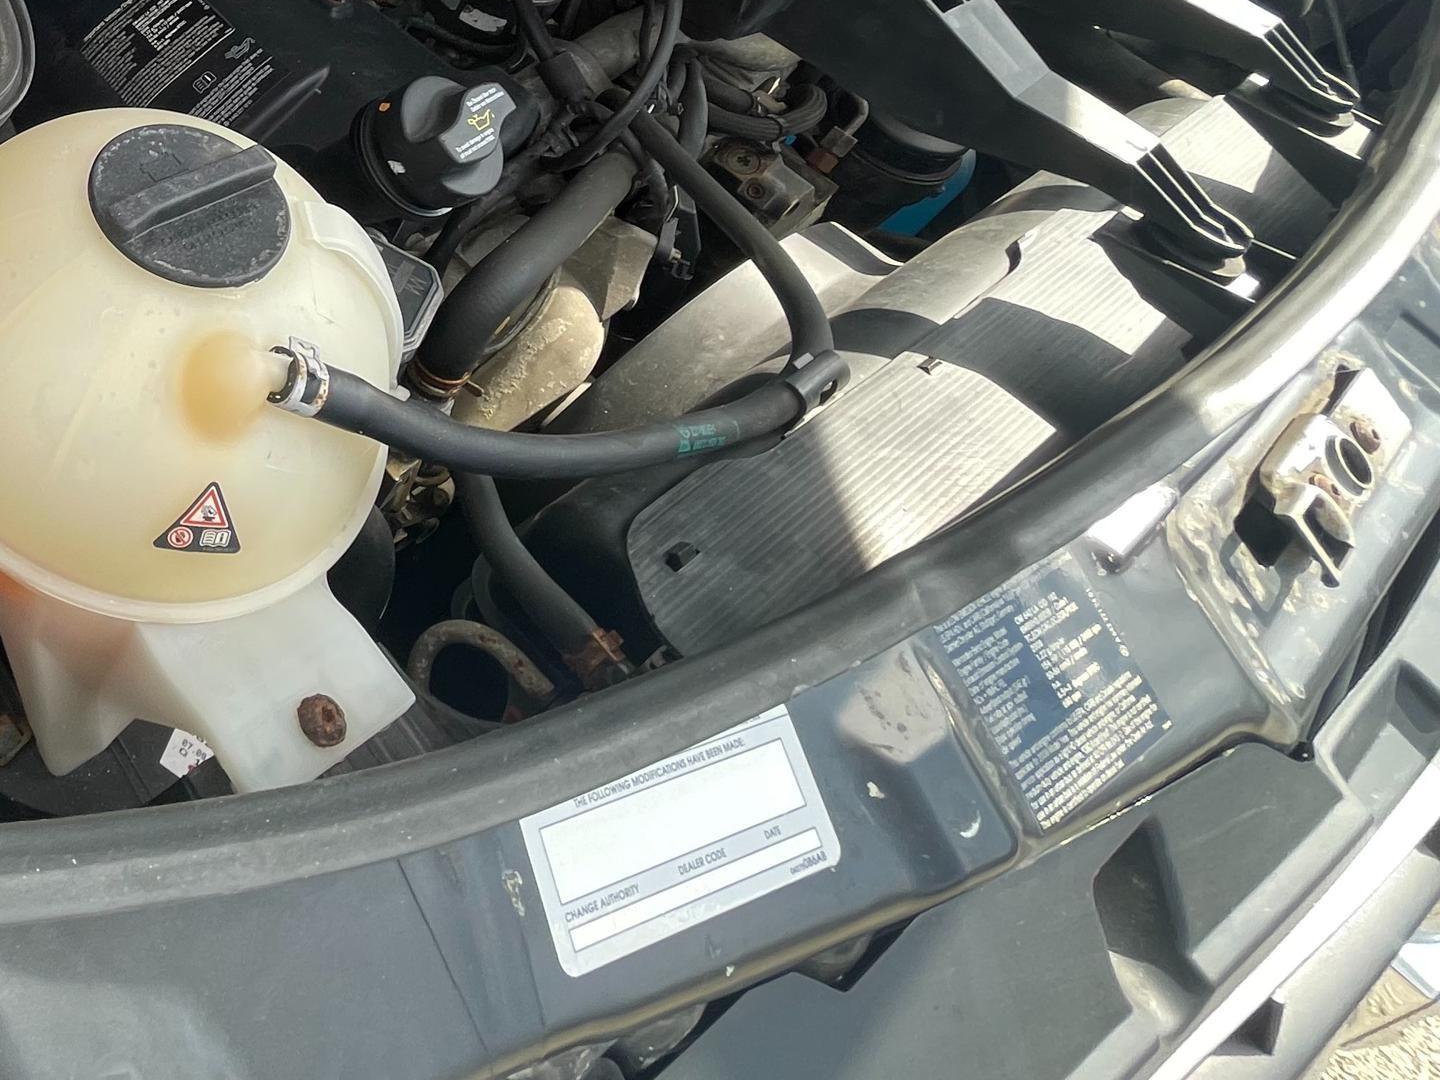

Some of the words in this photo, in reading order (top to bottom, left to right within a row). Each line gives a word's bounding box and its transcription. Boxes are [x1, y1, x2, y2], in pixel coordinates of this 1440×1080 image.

[573, 797, 587, 808] THE
[589, 780, 631, 803] FOLLOWING
[631, 760, 687, 785] MODIFICATIONS
[687, 752, 705, 766] HAVE
[705, 745, 723, 759] BEEN
[763, 826, 782, 840] DATE
[677, 856, 705, 875] DEALER
[704, 849, 727, 864] CODE
[564, 901, 599, 923] CHANGE
[599, 884, 641, 909] AUTHORITY
